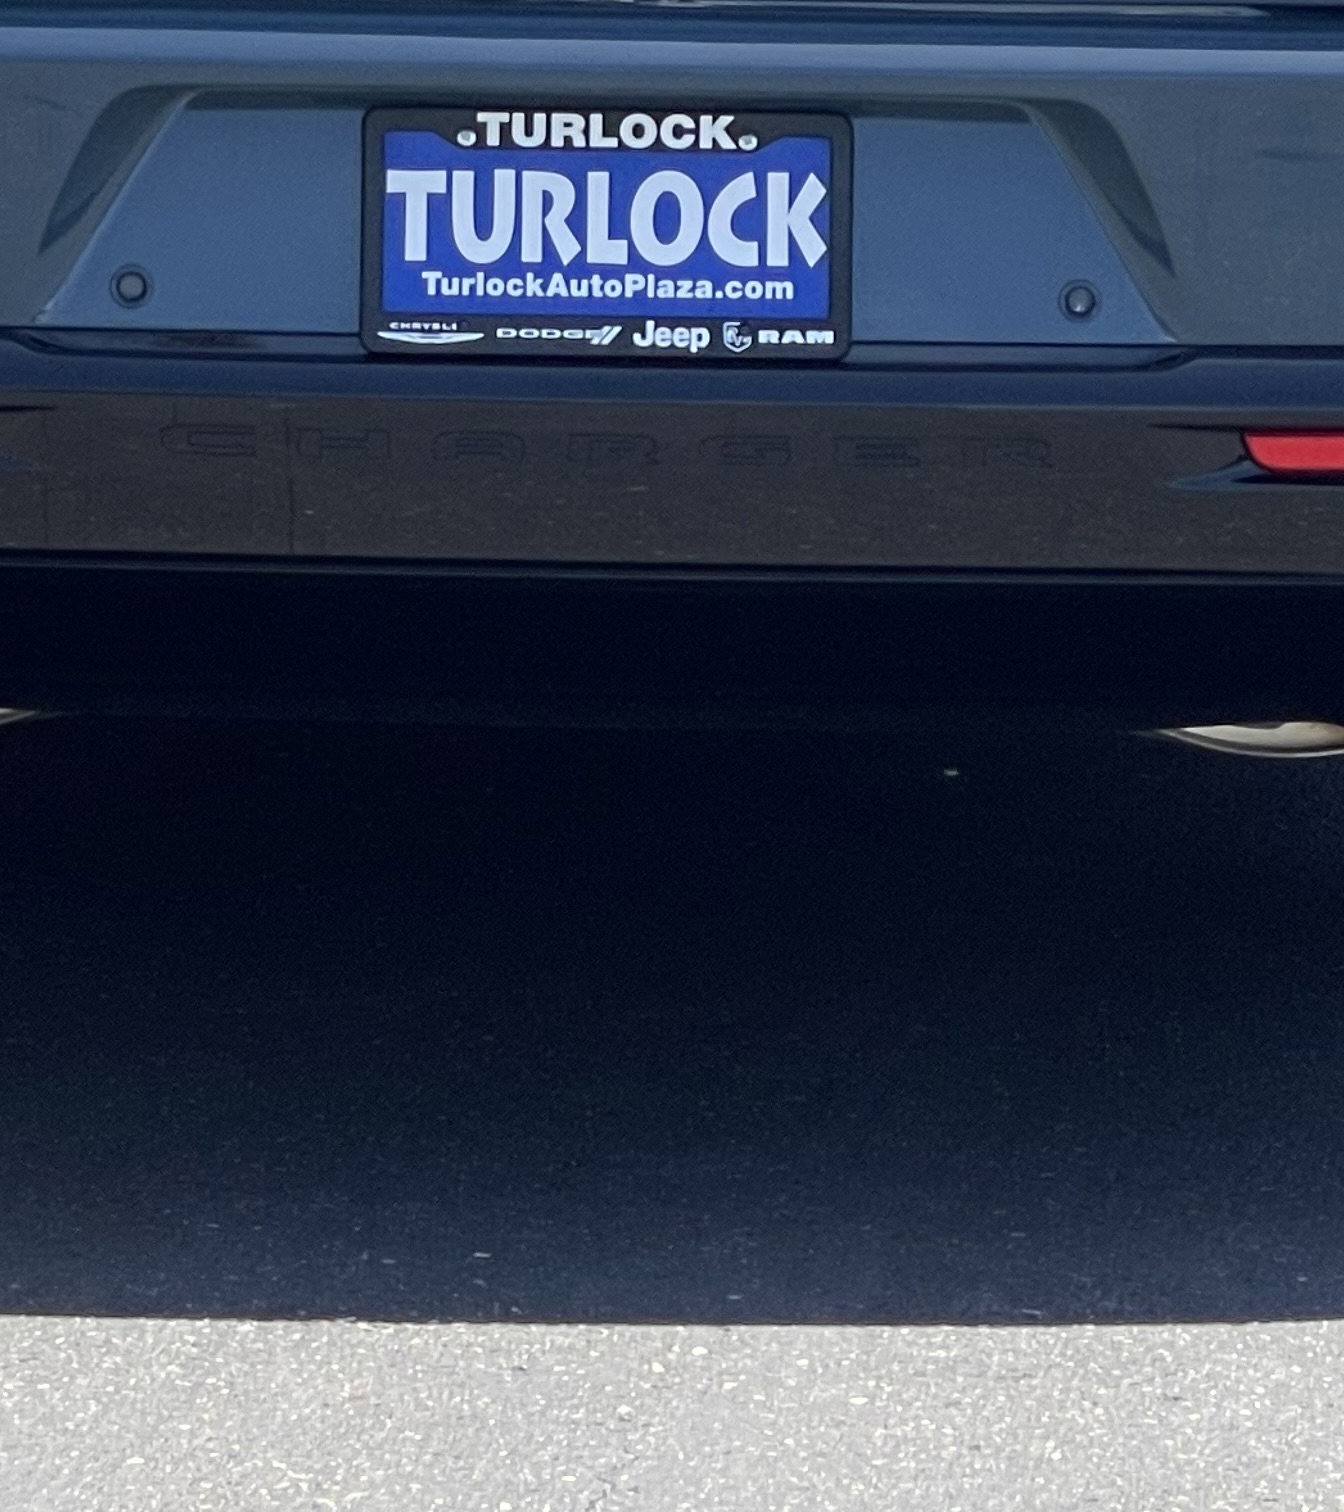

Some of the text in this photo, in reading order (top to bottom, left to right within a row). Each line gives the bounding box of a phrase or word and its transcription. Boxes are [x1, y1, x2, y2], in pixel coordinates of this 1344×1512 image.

[477, 112, 736, 150] TURLOCK
[386, 169, 827, 268] TURLOCK
[422, 271, 794, 300] TurlockAutoPlaza.com
[632, 320, 711, 354] Jeep
[758, 329, 835, 345] RAM
